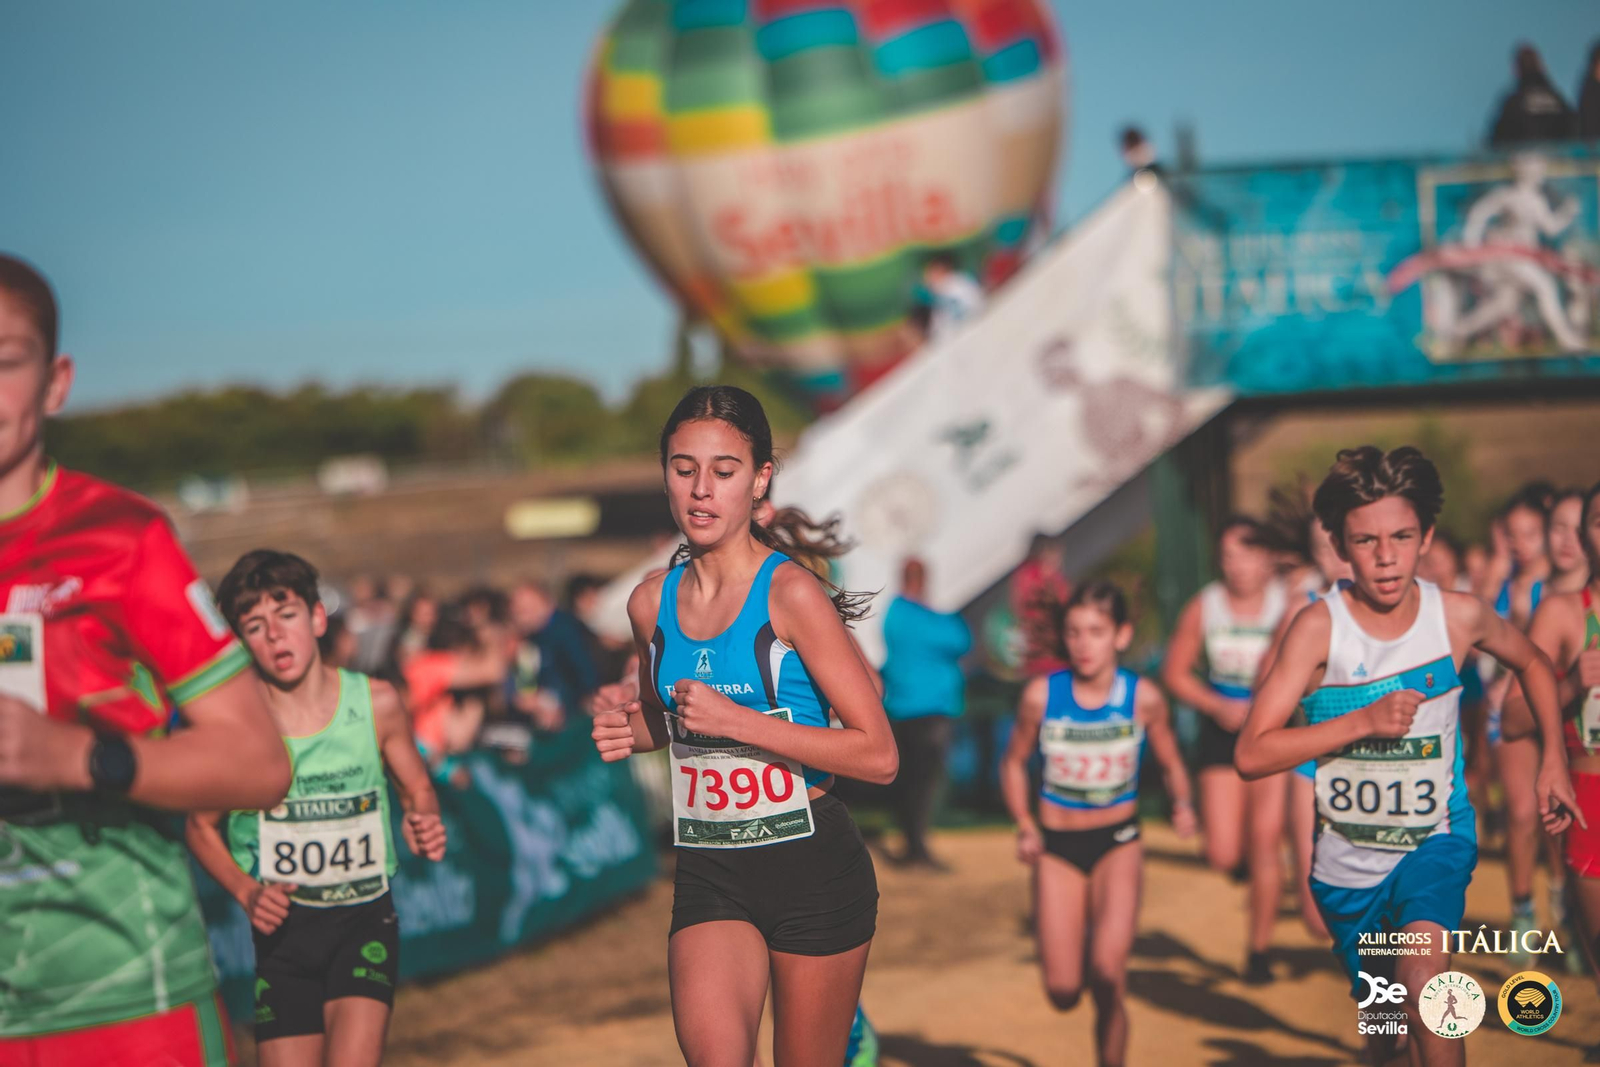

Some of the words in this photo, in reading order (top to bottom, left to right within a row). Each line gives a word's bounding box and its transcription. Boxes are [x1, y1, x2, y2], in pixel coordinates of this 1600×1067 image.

[664, 683, 754, 695] TIERRA
[680, 762, 794, 811] 7390
[1329, 777, 1437, 817] 8013
[274, 833, 376, 875] 8041
